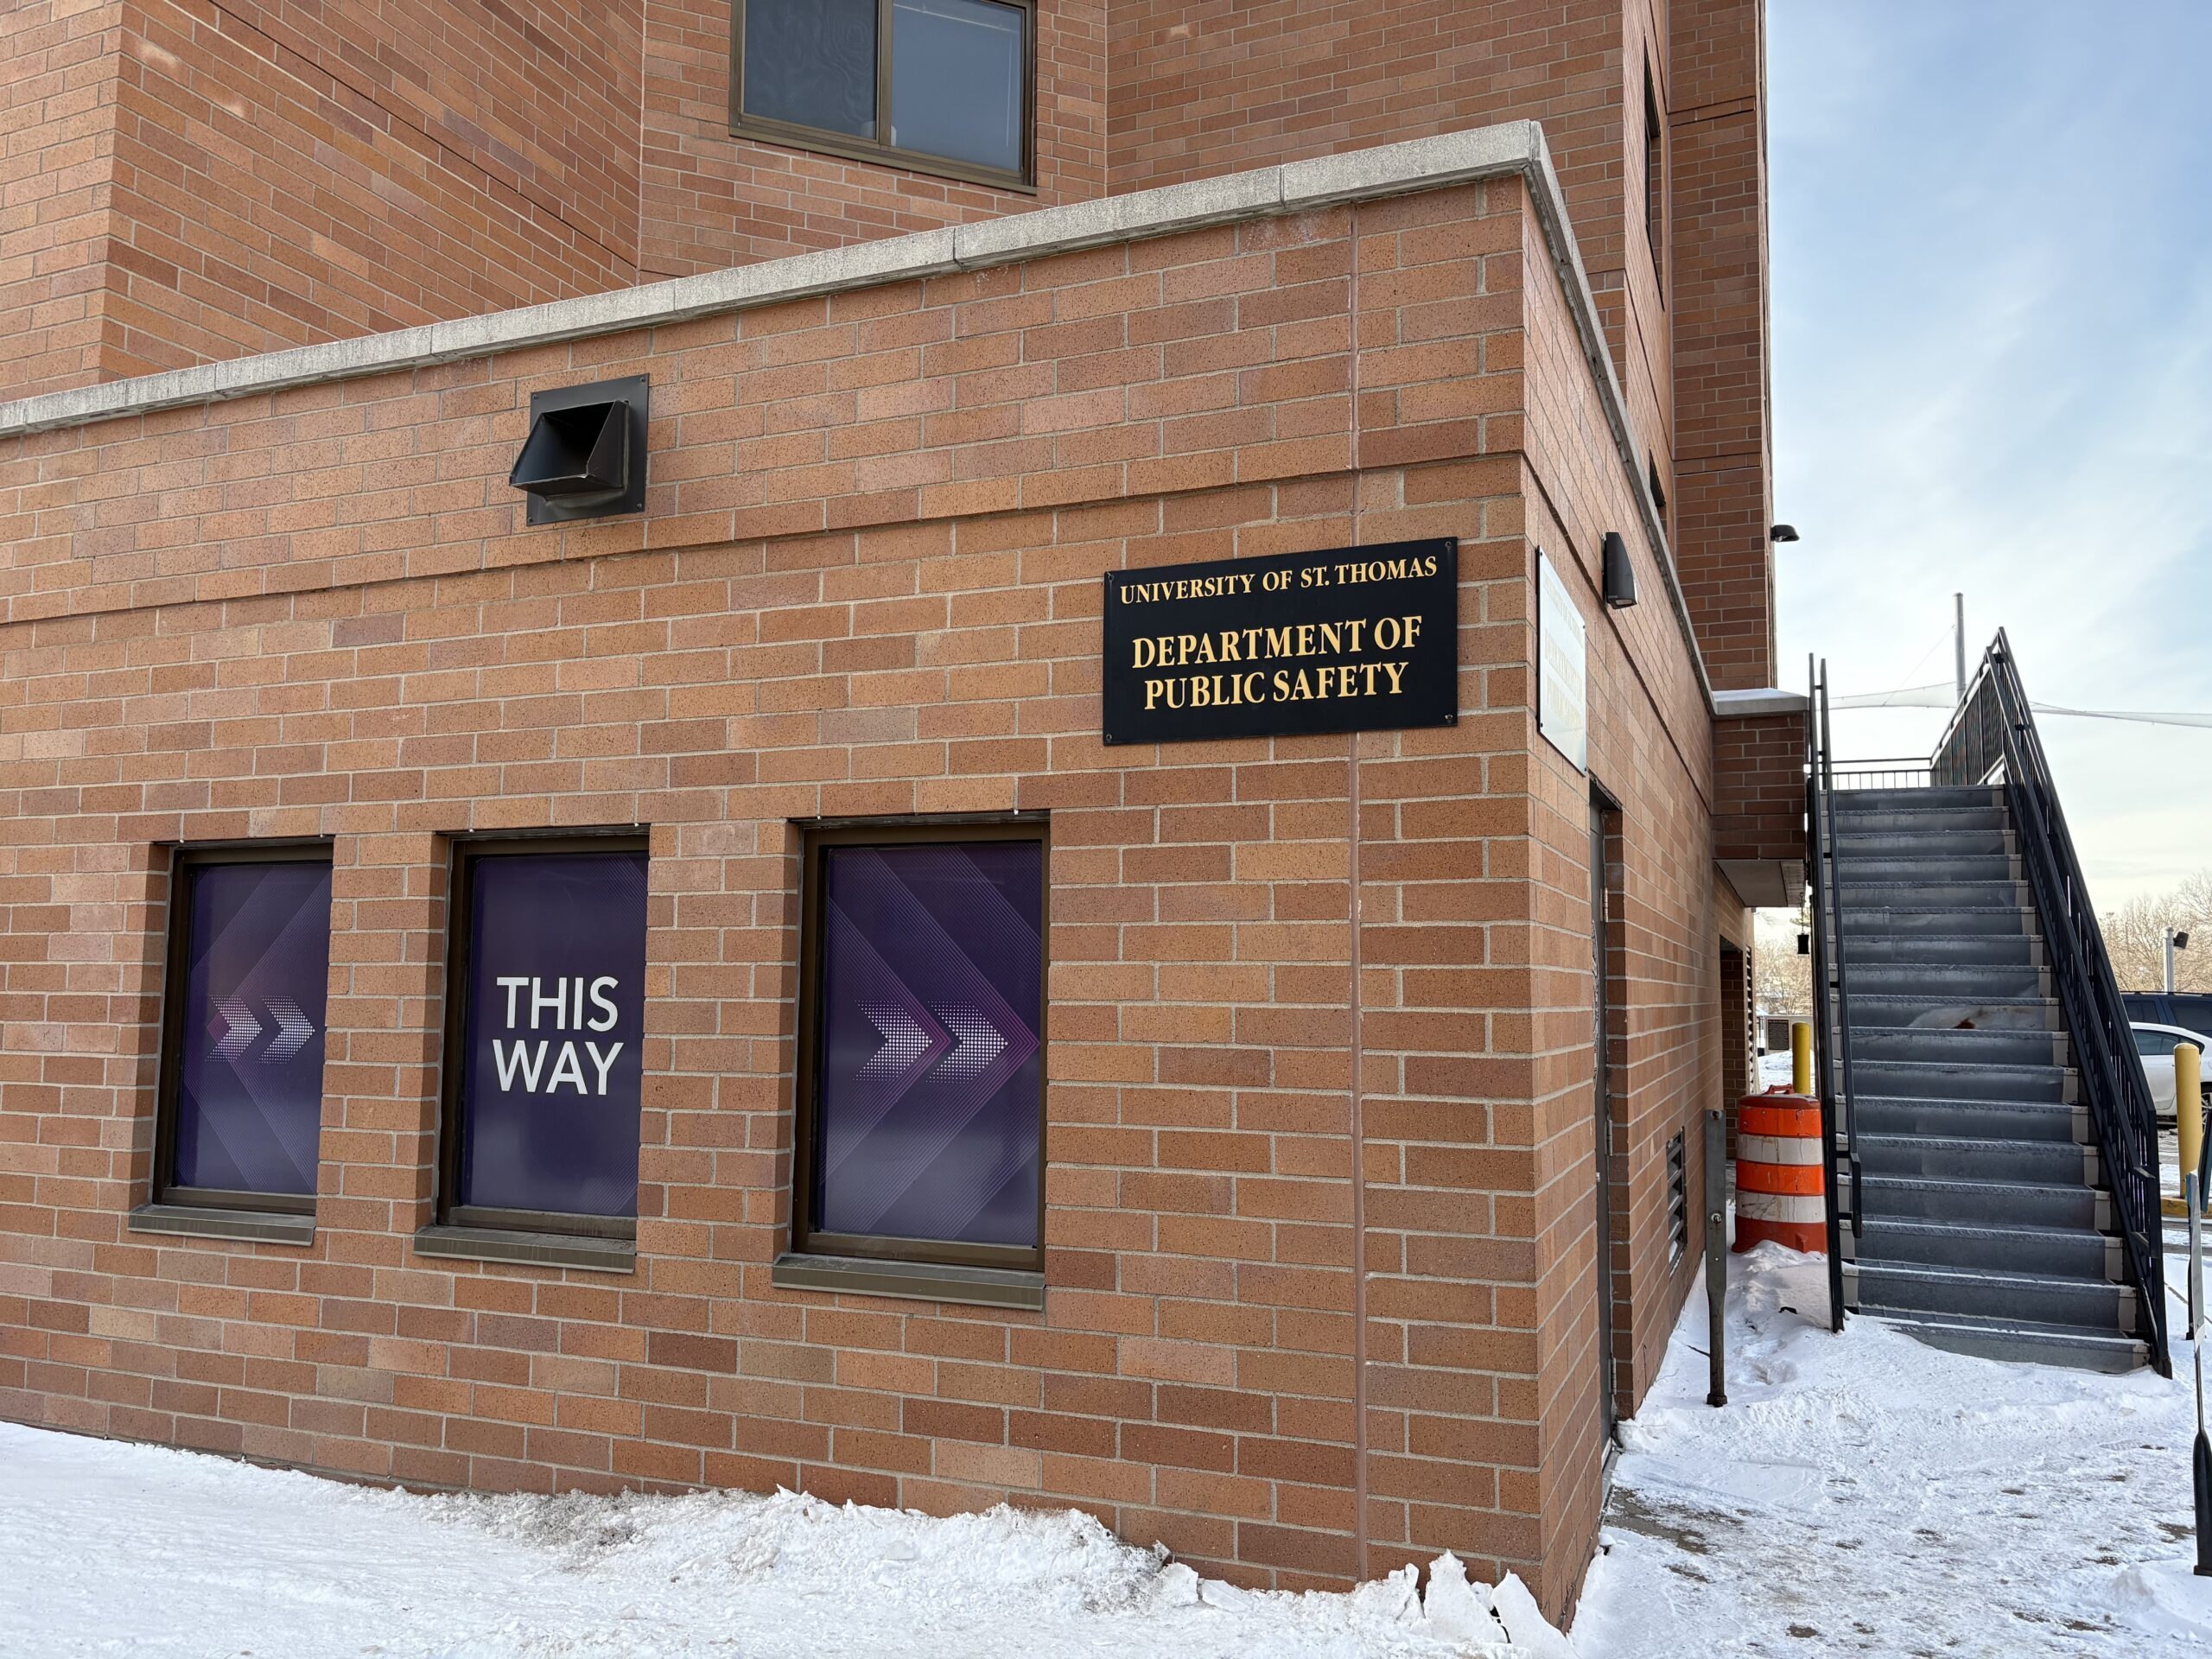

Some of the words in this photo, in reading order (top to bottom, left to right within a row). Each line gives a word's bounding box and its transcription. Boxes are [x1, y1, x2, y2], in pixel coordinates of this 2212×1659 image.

[1120, 574, 1255, 604] UNIVERSITY
[1262, 569, 1293, 592] OF
[1300, 565, 1331, 588] ST.
[1334, 556, 1437, 585] THOMAS
[1132, 618, 1367, 669] DEPARTMENT
[1374, 615, 1422, 650] OF
[1144, 671, 1265, 710] PUBLIC
[1273, 661, 1409, 702] SAFETY
[497, 976, 620, 1033] THIS
[492, 1039, 625, 1096] WAY
